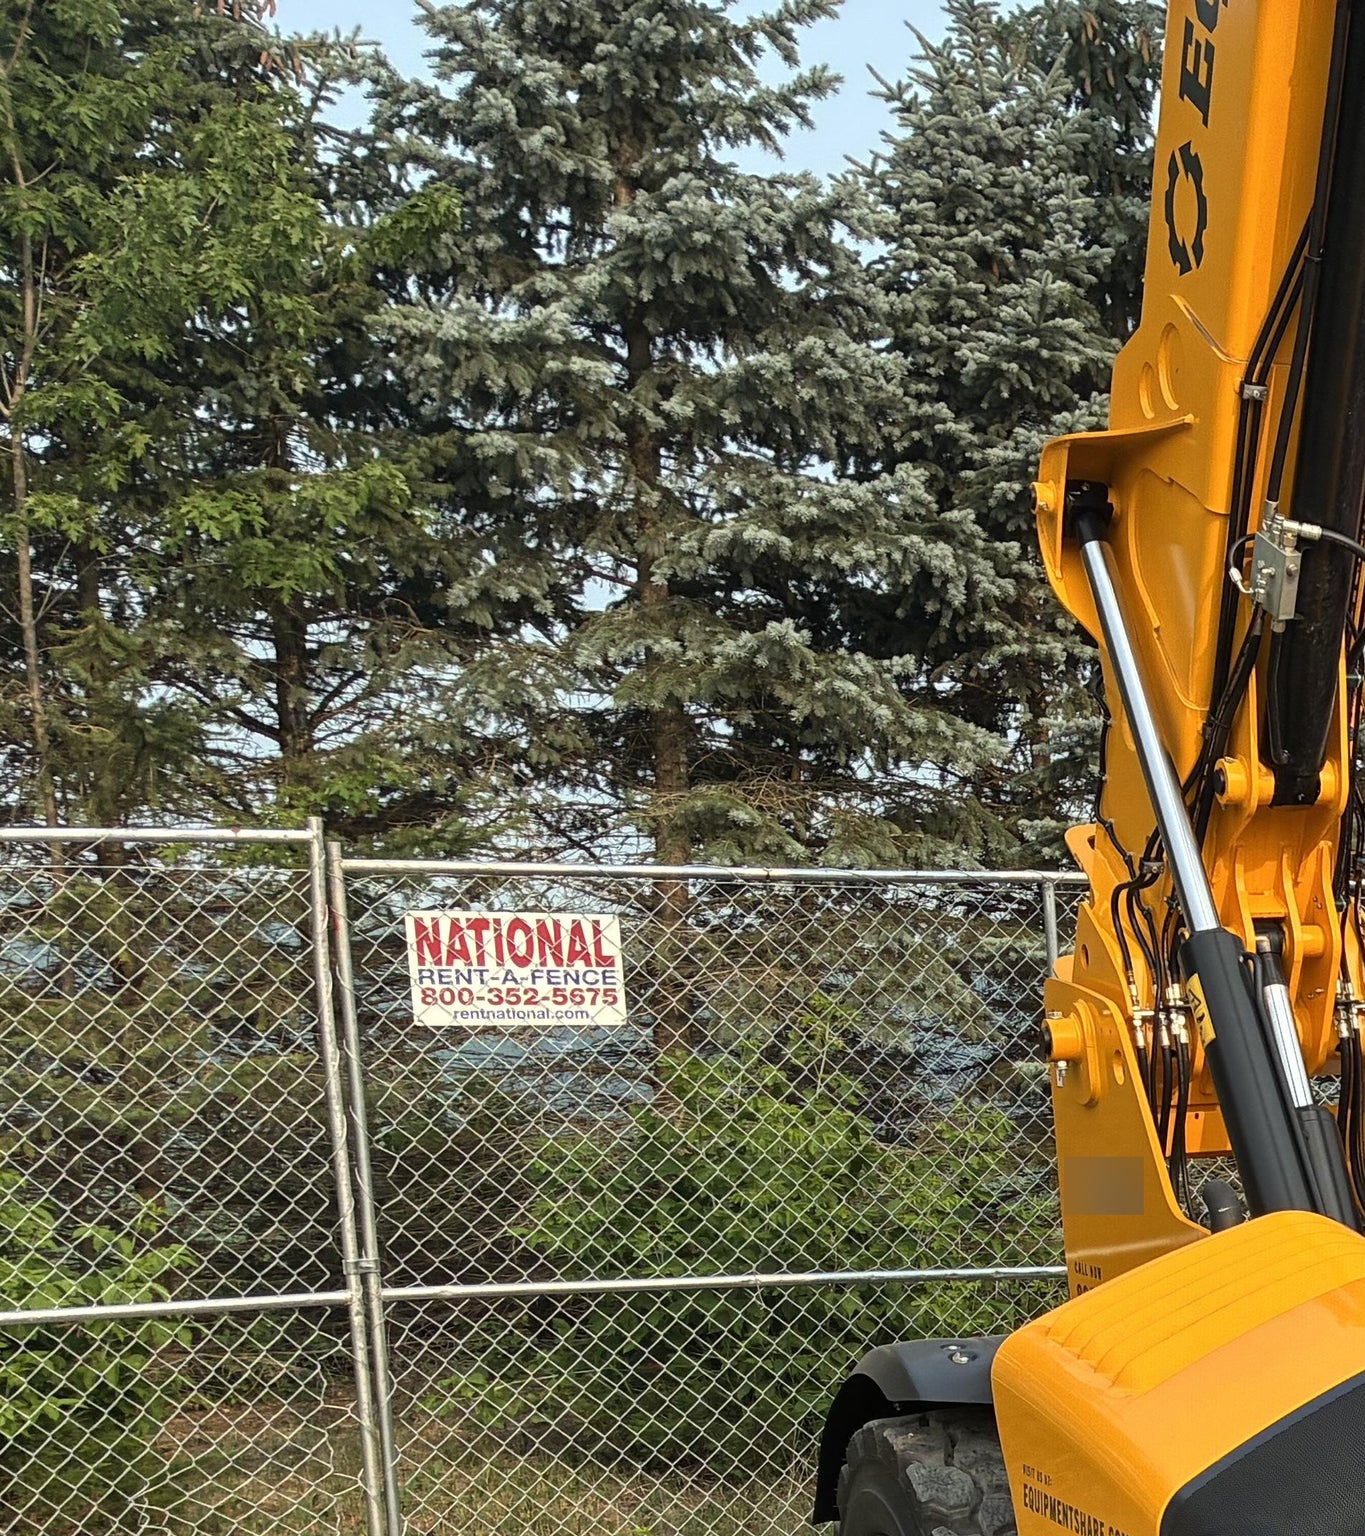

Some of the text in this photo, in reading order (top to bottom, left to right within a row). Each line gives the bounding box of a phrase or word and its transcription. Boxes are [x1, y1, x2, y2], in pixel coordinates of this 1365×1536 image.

[414, 917, 616, 968] NATIONAL
[418, 968, 618, 985] RENT-A-FENCE
[421, 987, 618, 1006] 800-352-5675
[454, 1007, 590, 1020] rentnational.com
